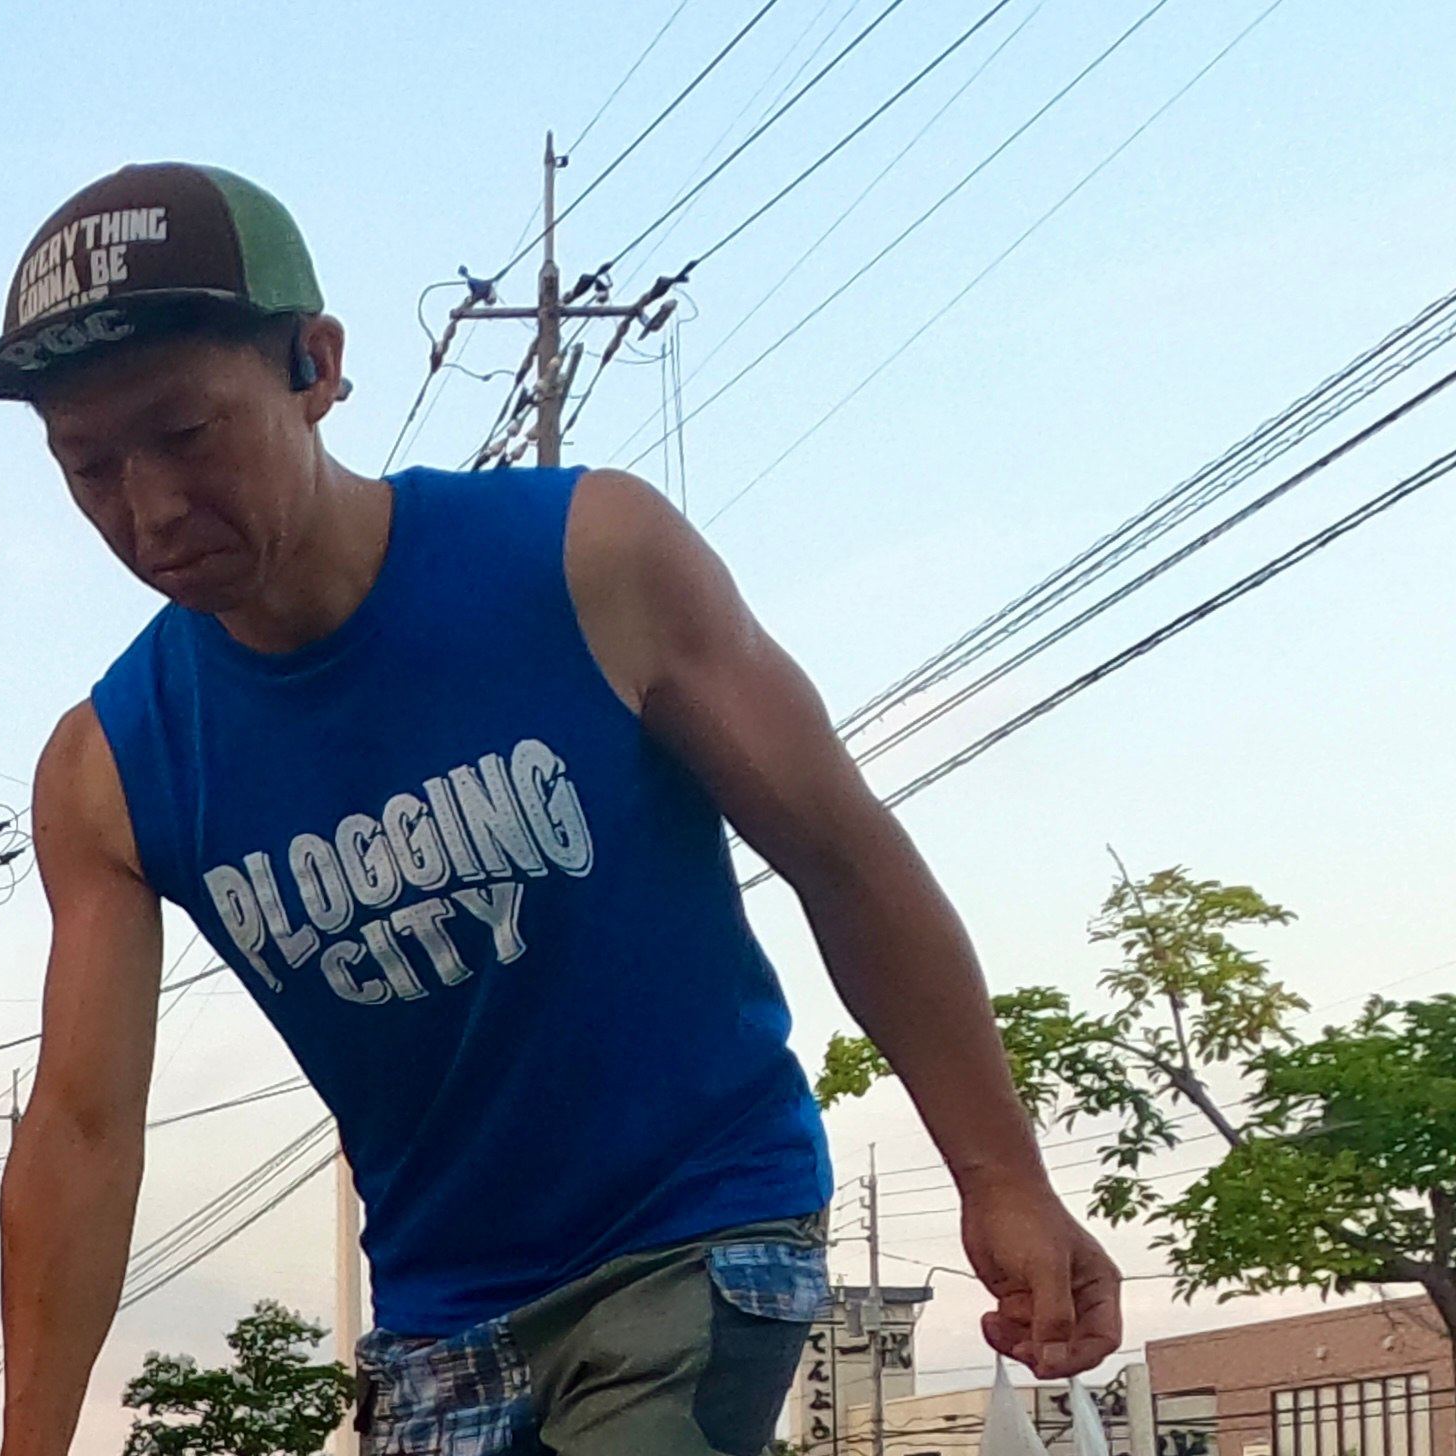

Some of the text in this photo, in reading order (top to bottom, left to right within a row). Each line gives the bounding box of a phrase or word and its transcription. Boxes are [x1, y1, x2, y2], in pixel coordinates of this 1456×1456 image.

[18, 258, 81, 326] GONNA
[90, 244, 129, 287] BE
[20, 206, 168, 294] EVERYTHING
[203, 738, 594, 993] PLOGGING
[321, 882, 527, 1005] CITY
